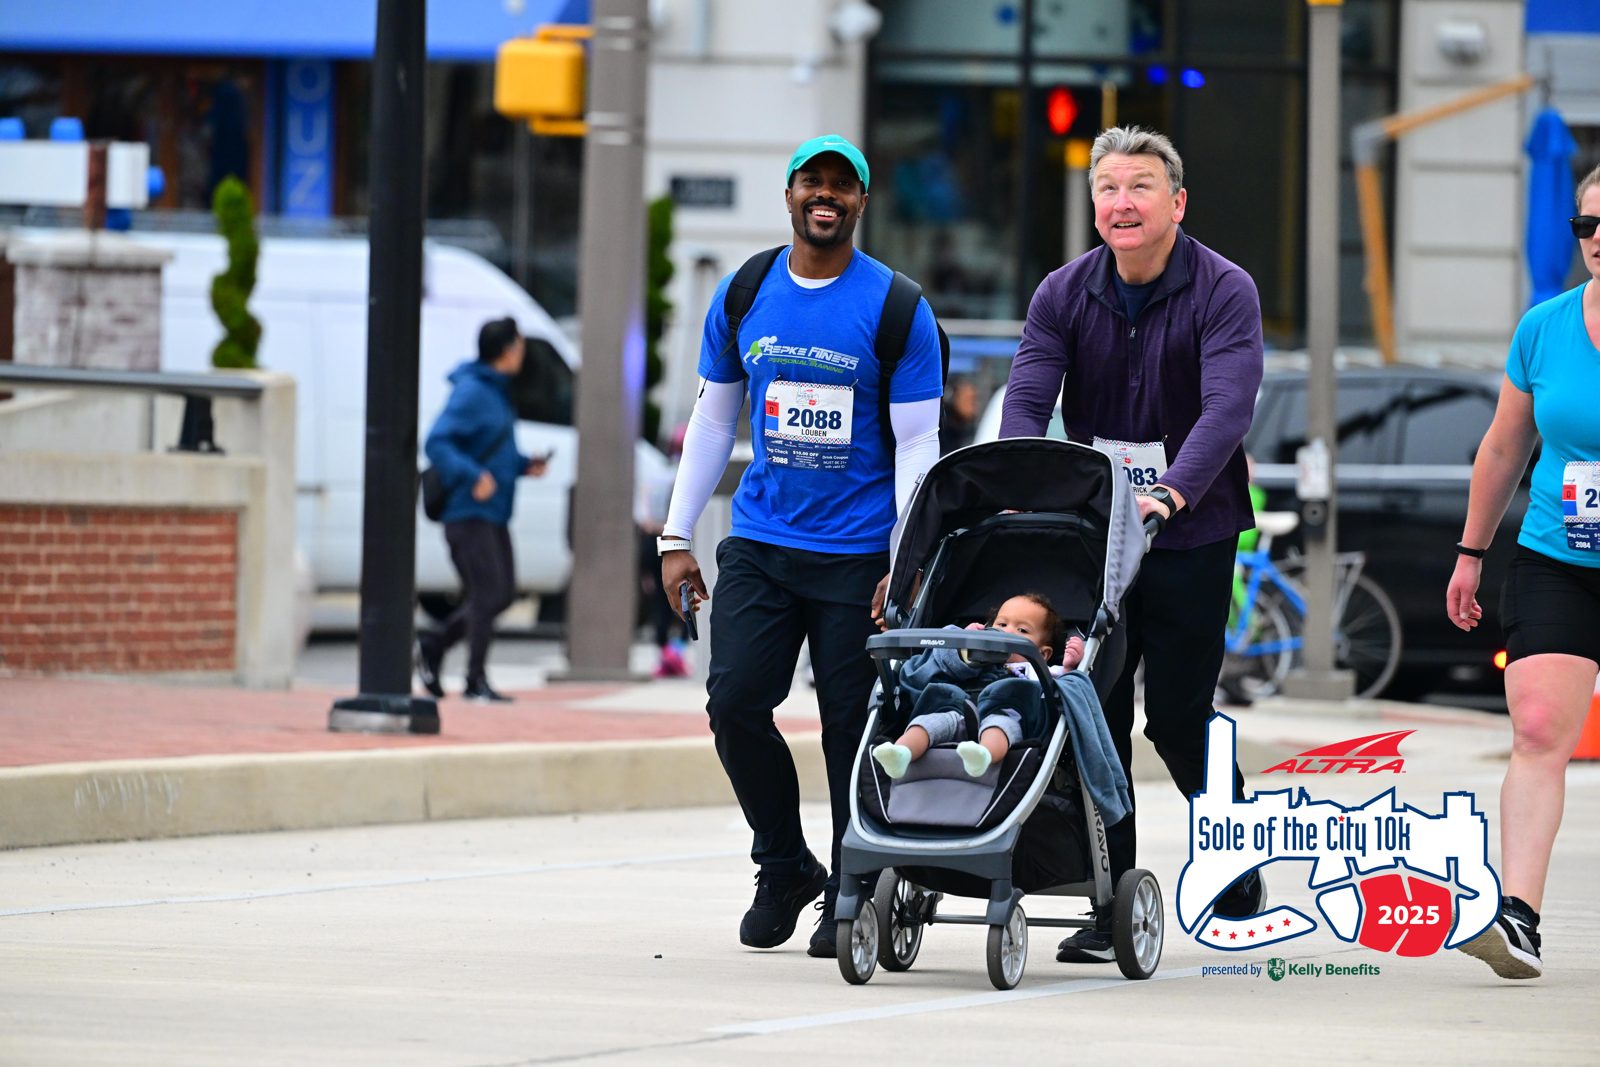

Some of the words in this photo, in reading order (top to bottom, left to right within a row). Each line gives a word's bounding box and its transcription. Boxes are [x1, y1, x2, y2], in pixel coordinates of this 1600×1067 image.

[787, 408, 842, 430] 2088
[801, 428, 827, 437] LOUBEN
[772, 456, 788, 465] 2088
[1575, 541, 1591, 549] 2084
